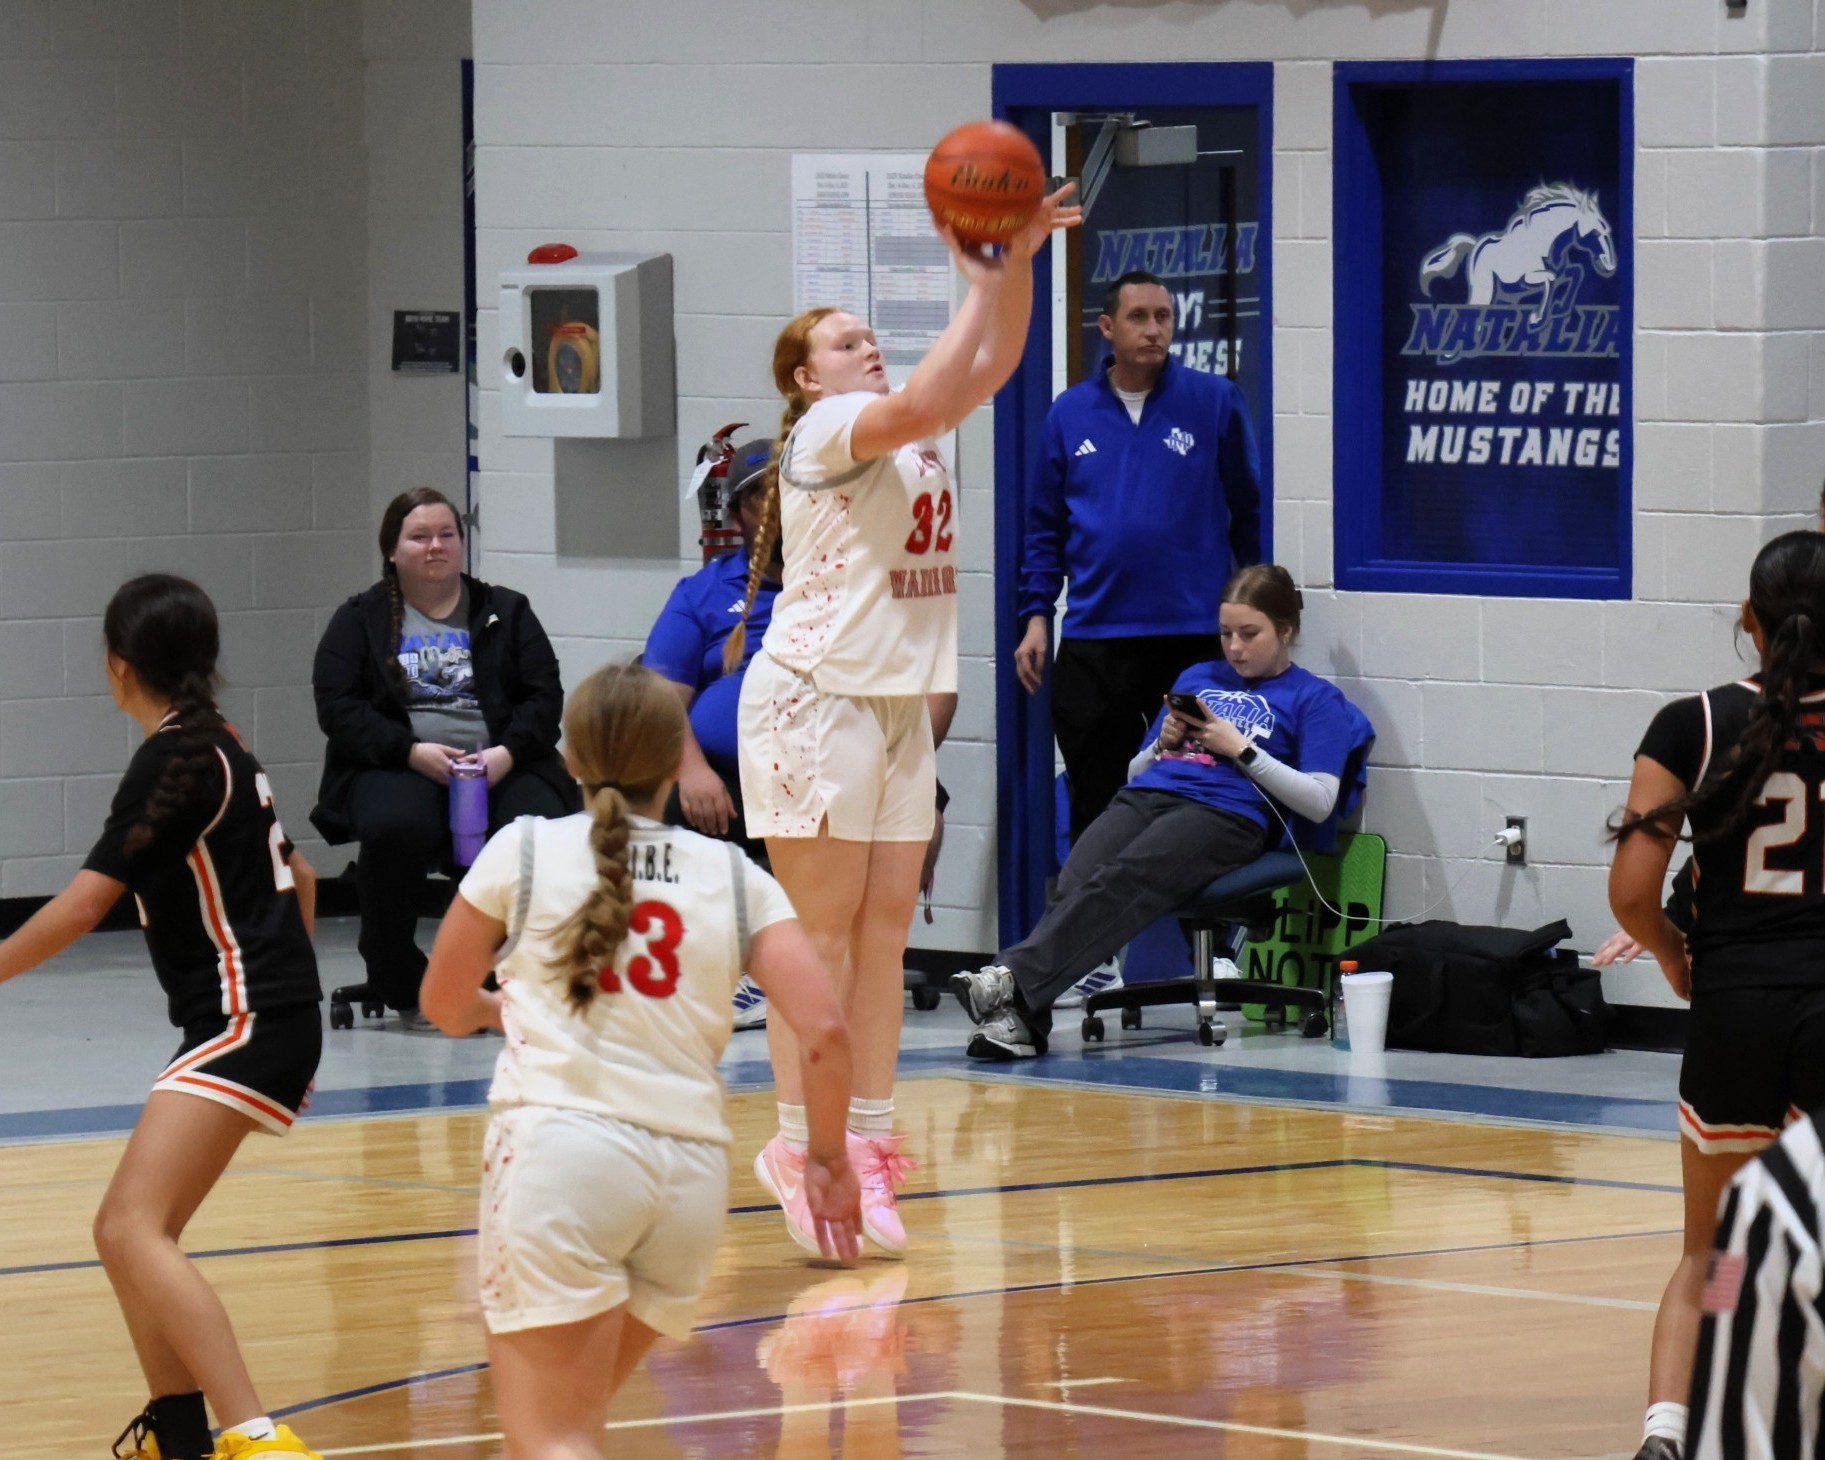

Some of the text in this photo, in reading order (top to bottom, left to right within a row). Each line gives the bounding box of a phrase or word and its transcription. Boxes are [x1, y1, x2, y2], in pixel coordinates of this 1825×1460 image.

[1404, 379, 1501, 414] HOME
[1509, 381, 1555, 415] OF
[1406, 424, 1620, 468] MUSTANGS
[904, 488, 953, 556] 32
[1203, 699, 1276, 734] TALIA
[1742, 771, 1825, 894] 2
[630, 843, 680, 884] I.B.E.
[598, 900, 685, 998] 3
